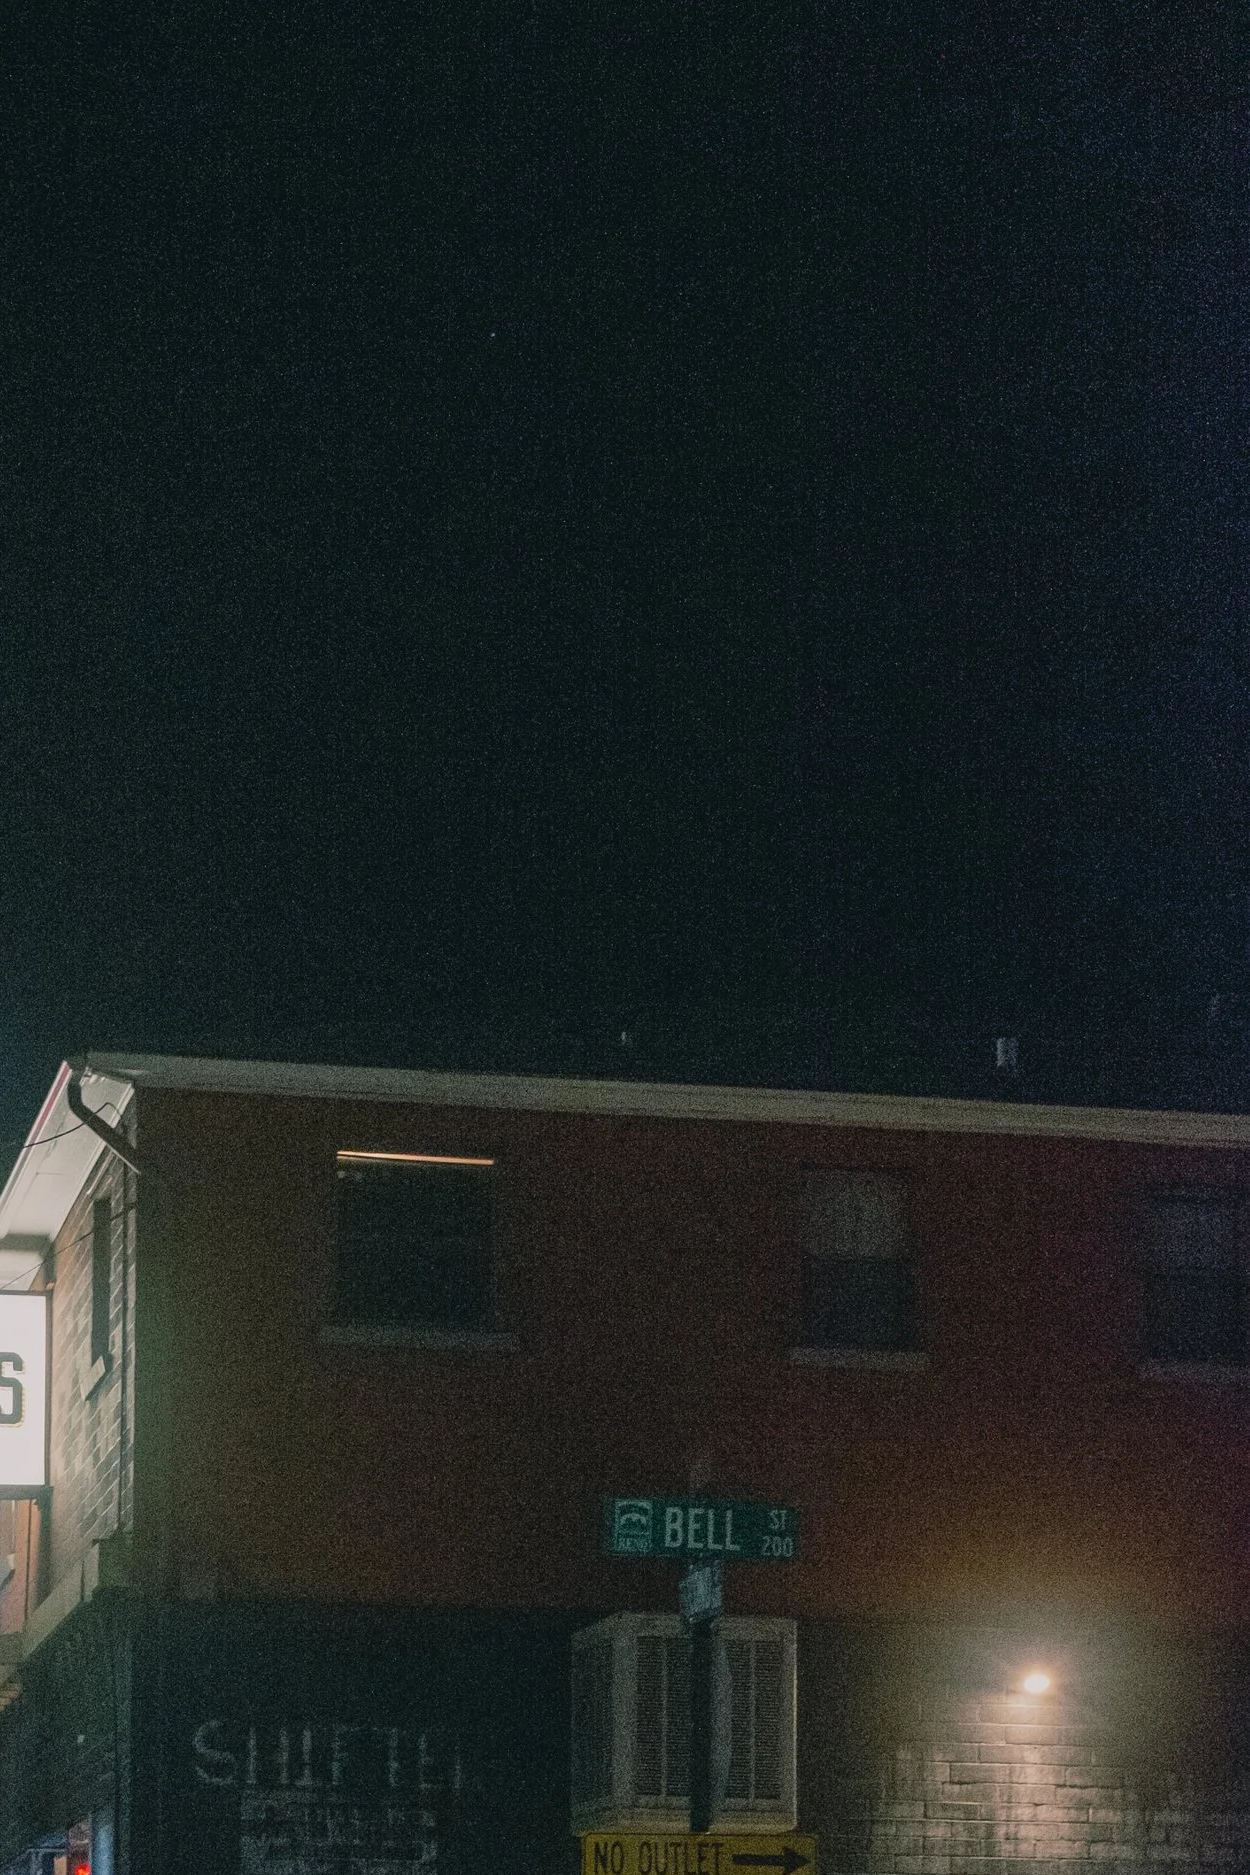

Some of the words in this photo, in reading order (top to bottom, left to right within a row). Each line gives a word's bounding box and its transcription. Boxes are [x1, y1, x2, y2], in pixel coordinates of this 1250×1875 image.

[664, 1506, 741, 1551] BELL
[768, 1509, 788, 1530] ST
[761, 1535, 794, 1558] 200
[594, 1840, 626, 1875] NO
